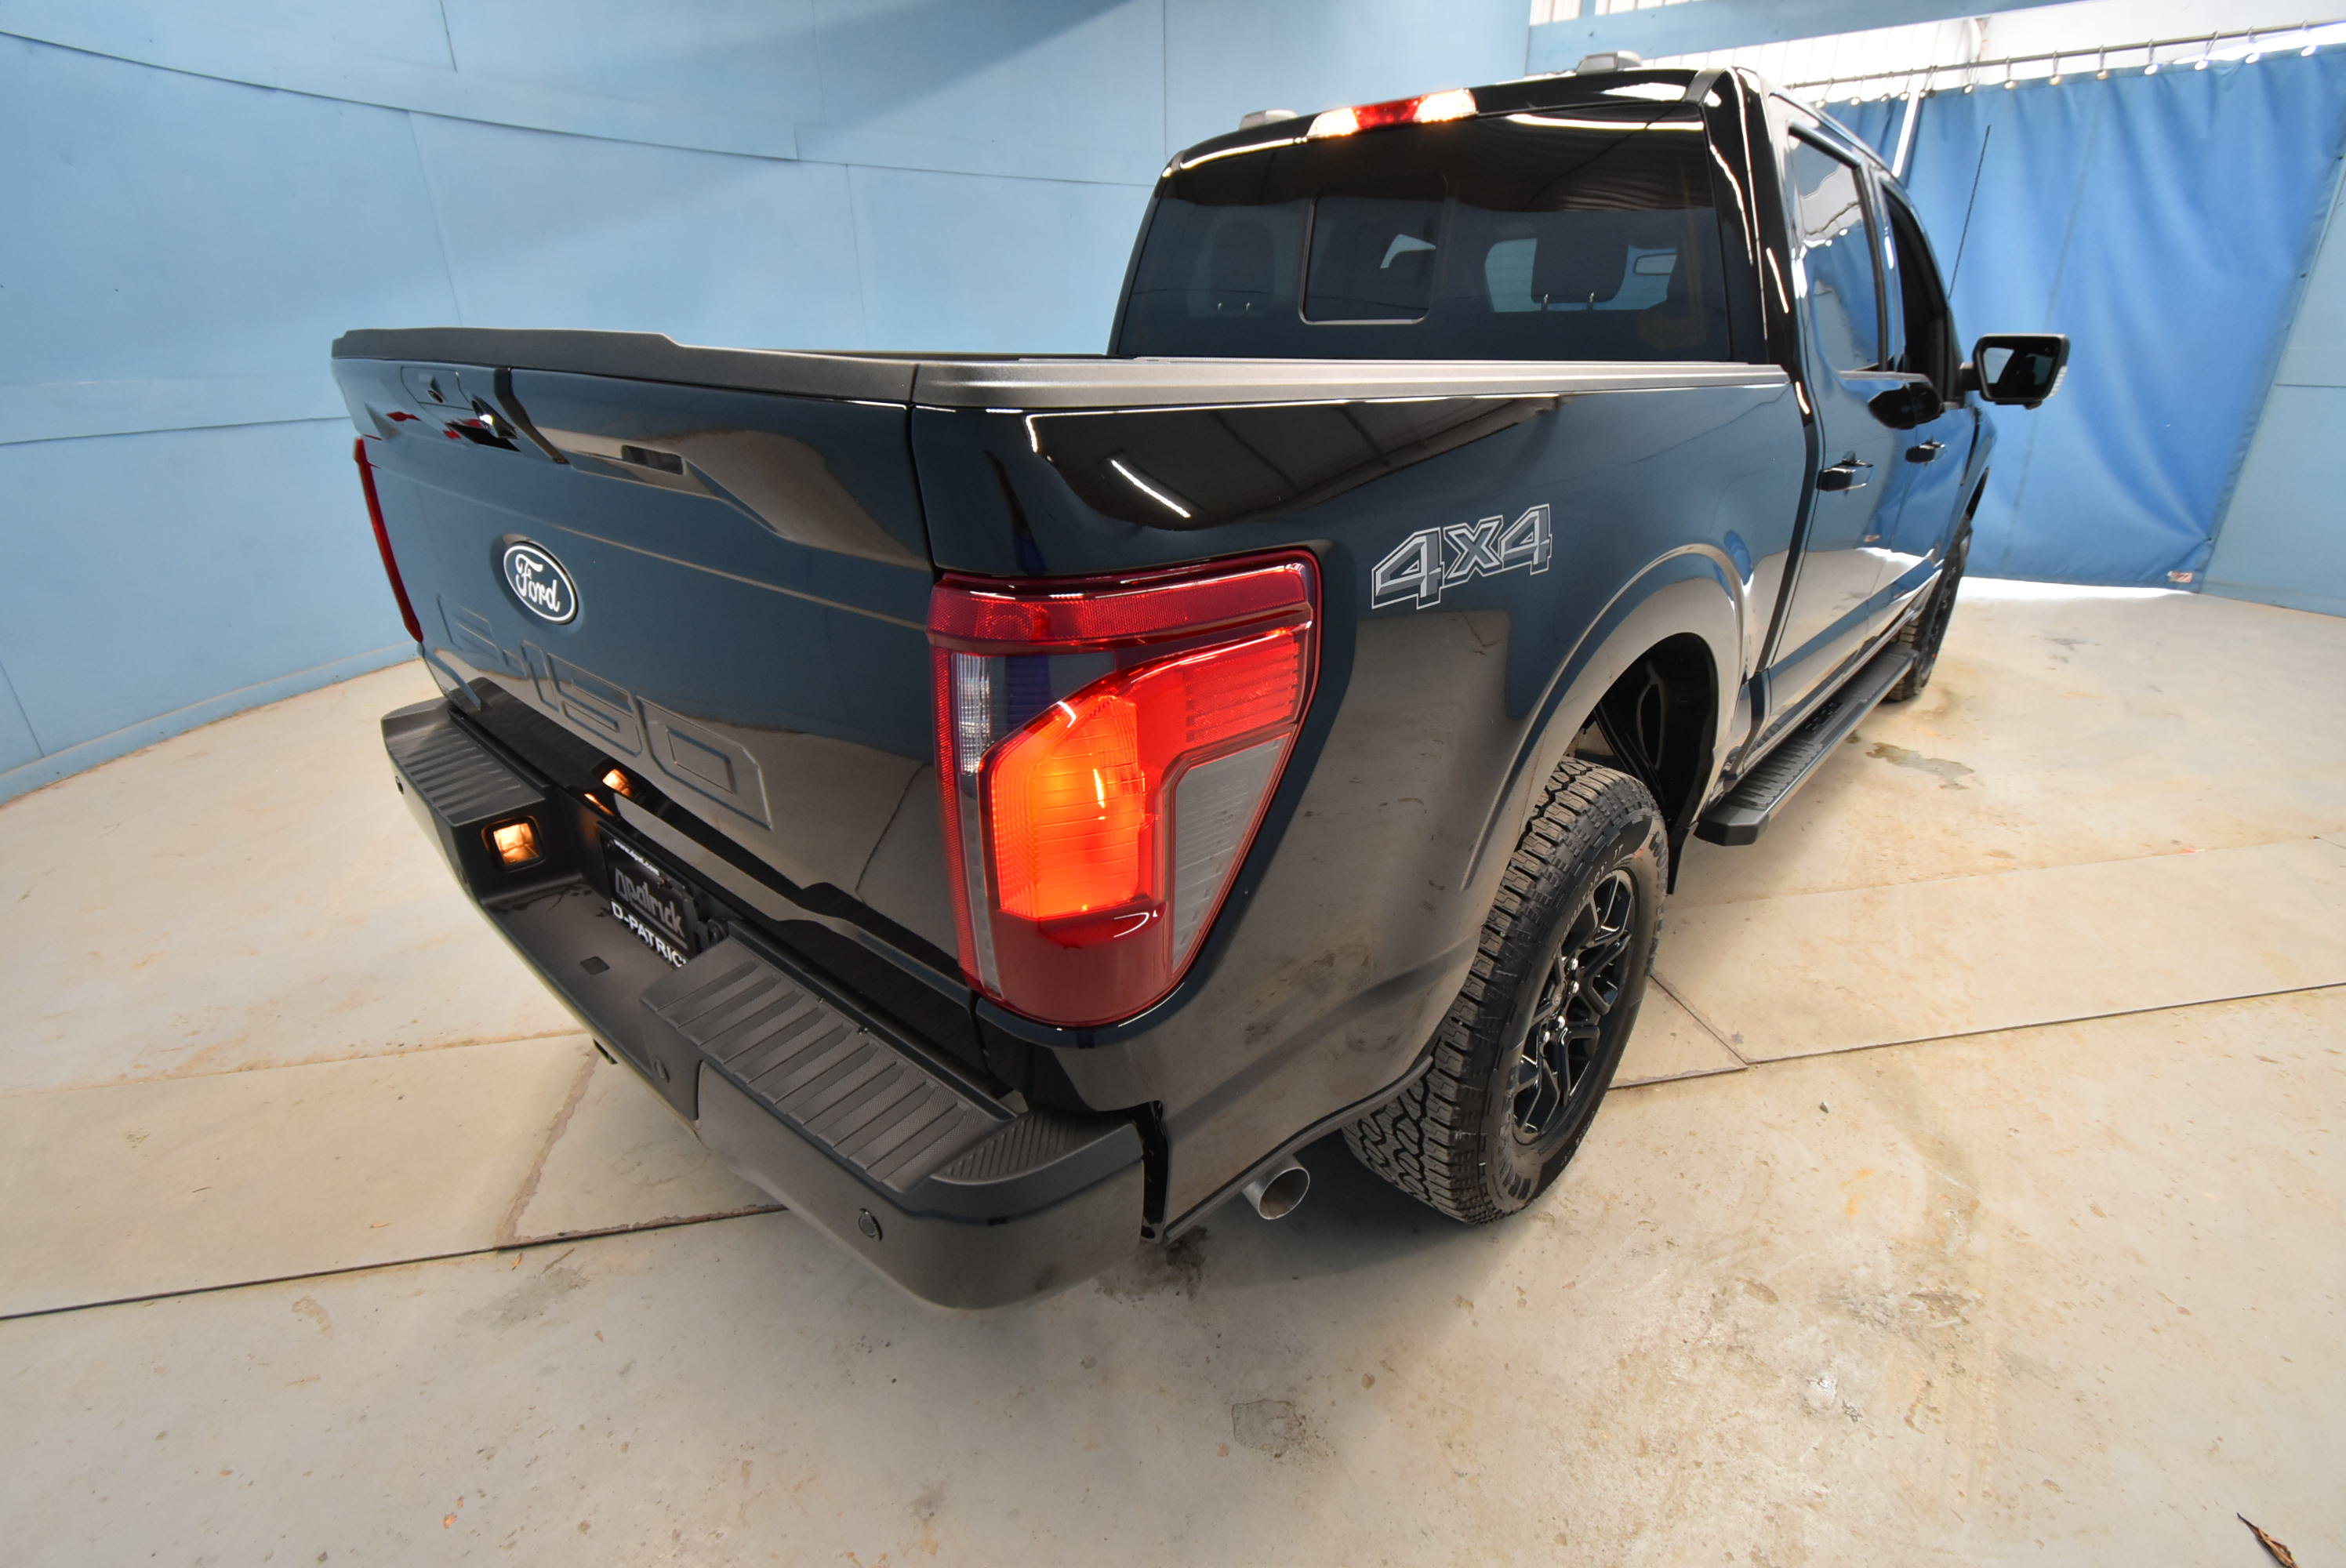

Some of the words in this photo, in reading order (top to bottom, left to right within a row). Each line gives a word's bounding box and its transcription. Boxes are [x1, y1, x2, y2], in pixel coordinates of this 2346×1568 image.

[515, 554, 561, 612] Ford
[437, 593, 773, 831] F-150
[611, 901, 687, 968] D-PATRIC
